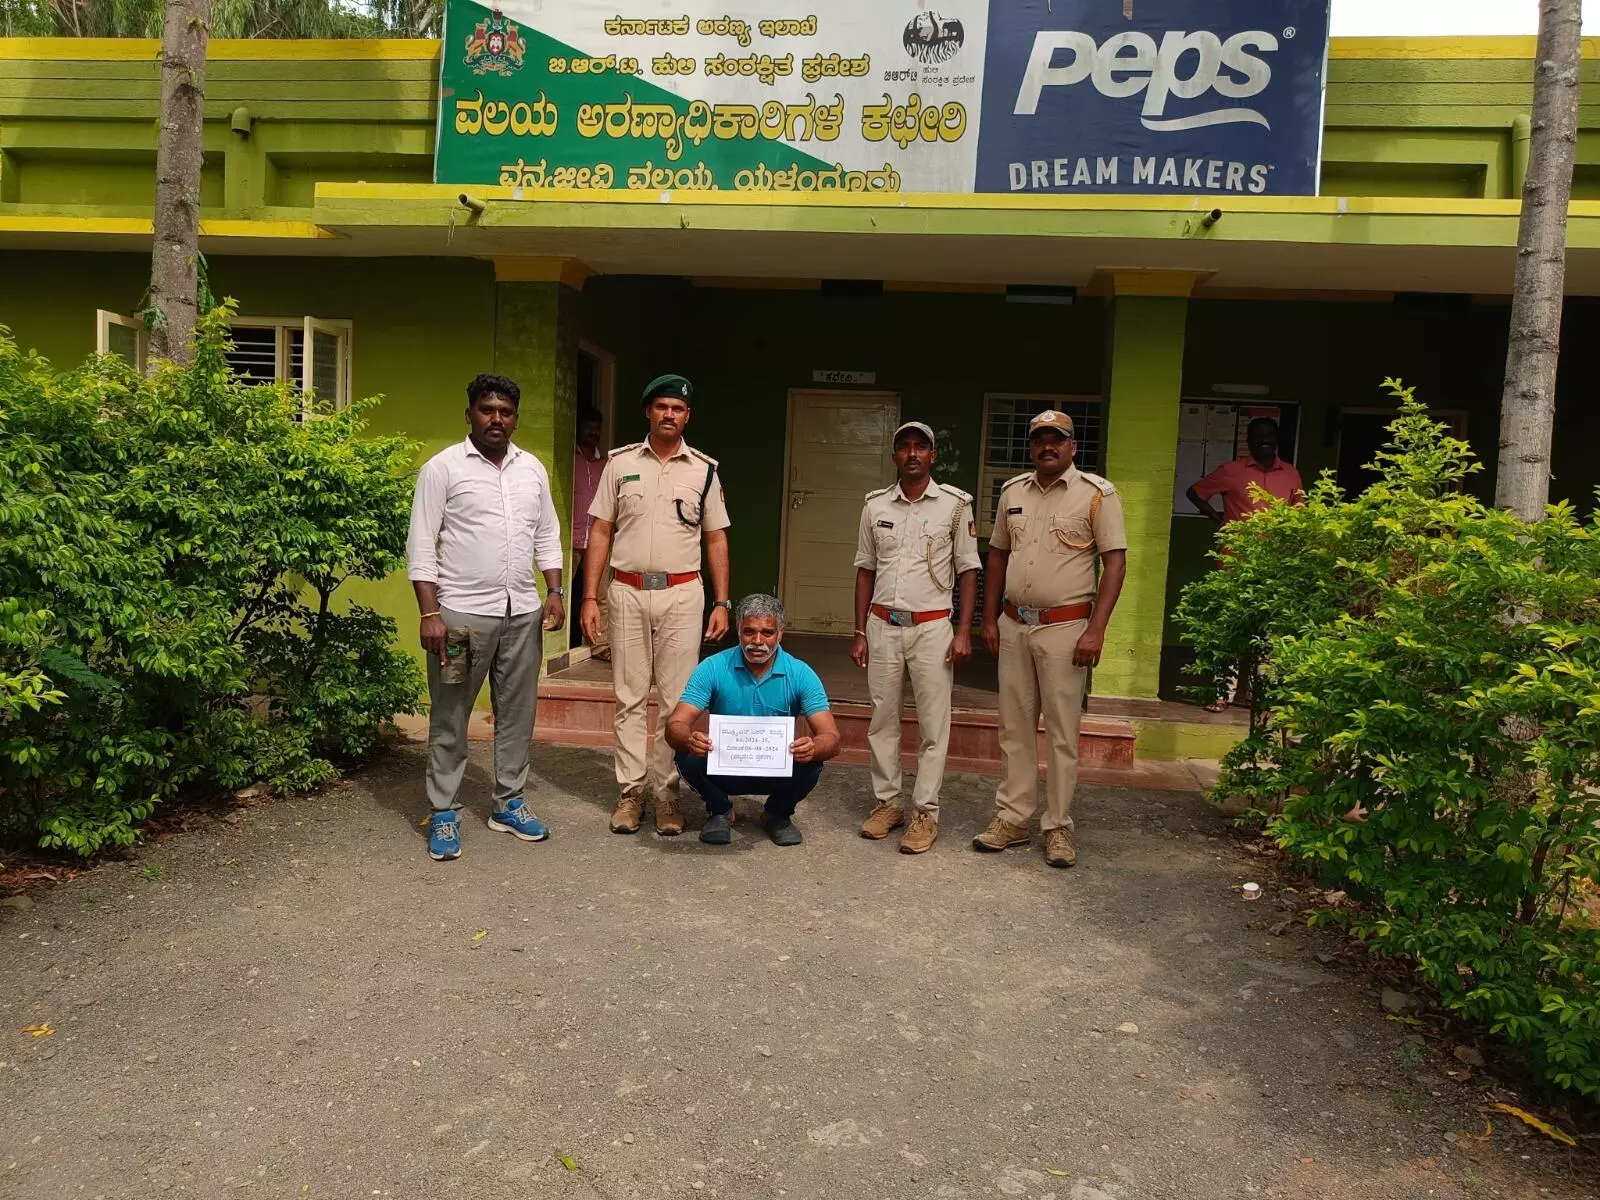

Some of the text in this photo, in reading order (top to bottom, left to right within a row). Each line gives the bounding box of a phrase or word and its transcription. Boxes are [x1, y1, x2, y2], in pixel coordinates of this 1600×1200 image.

[604, 15, 818, 47] ಕರ್ನಾಟಕ ಅರಣ್ಯ ಇಲಾಖೆ
[548, 54, 644, 75] ಬಿ.ಆರ್.ಟಿ.
[652, 52, 697, 76] ಹುಲಿ
[704, 52, 794, 86] ಸಂರಕ್ಷಿತ
[802, 53, 871, 83] ಪ್ರದೇಶ
[455, 88, 968, 161] ವಲಯ ಅರಣ್ಯಾಧಿಕಾರಿಗಳ ಕಛೇರಿ
[1008, 156, 1268, 194] DREAM MAKERS
